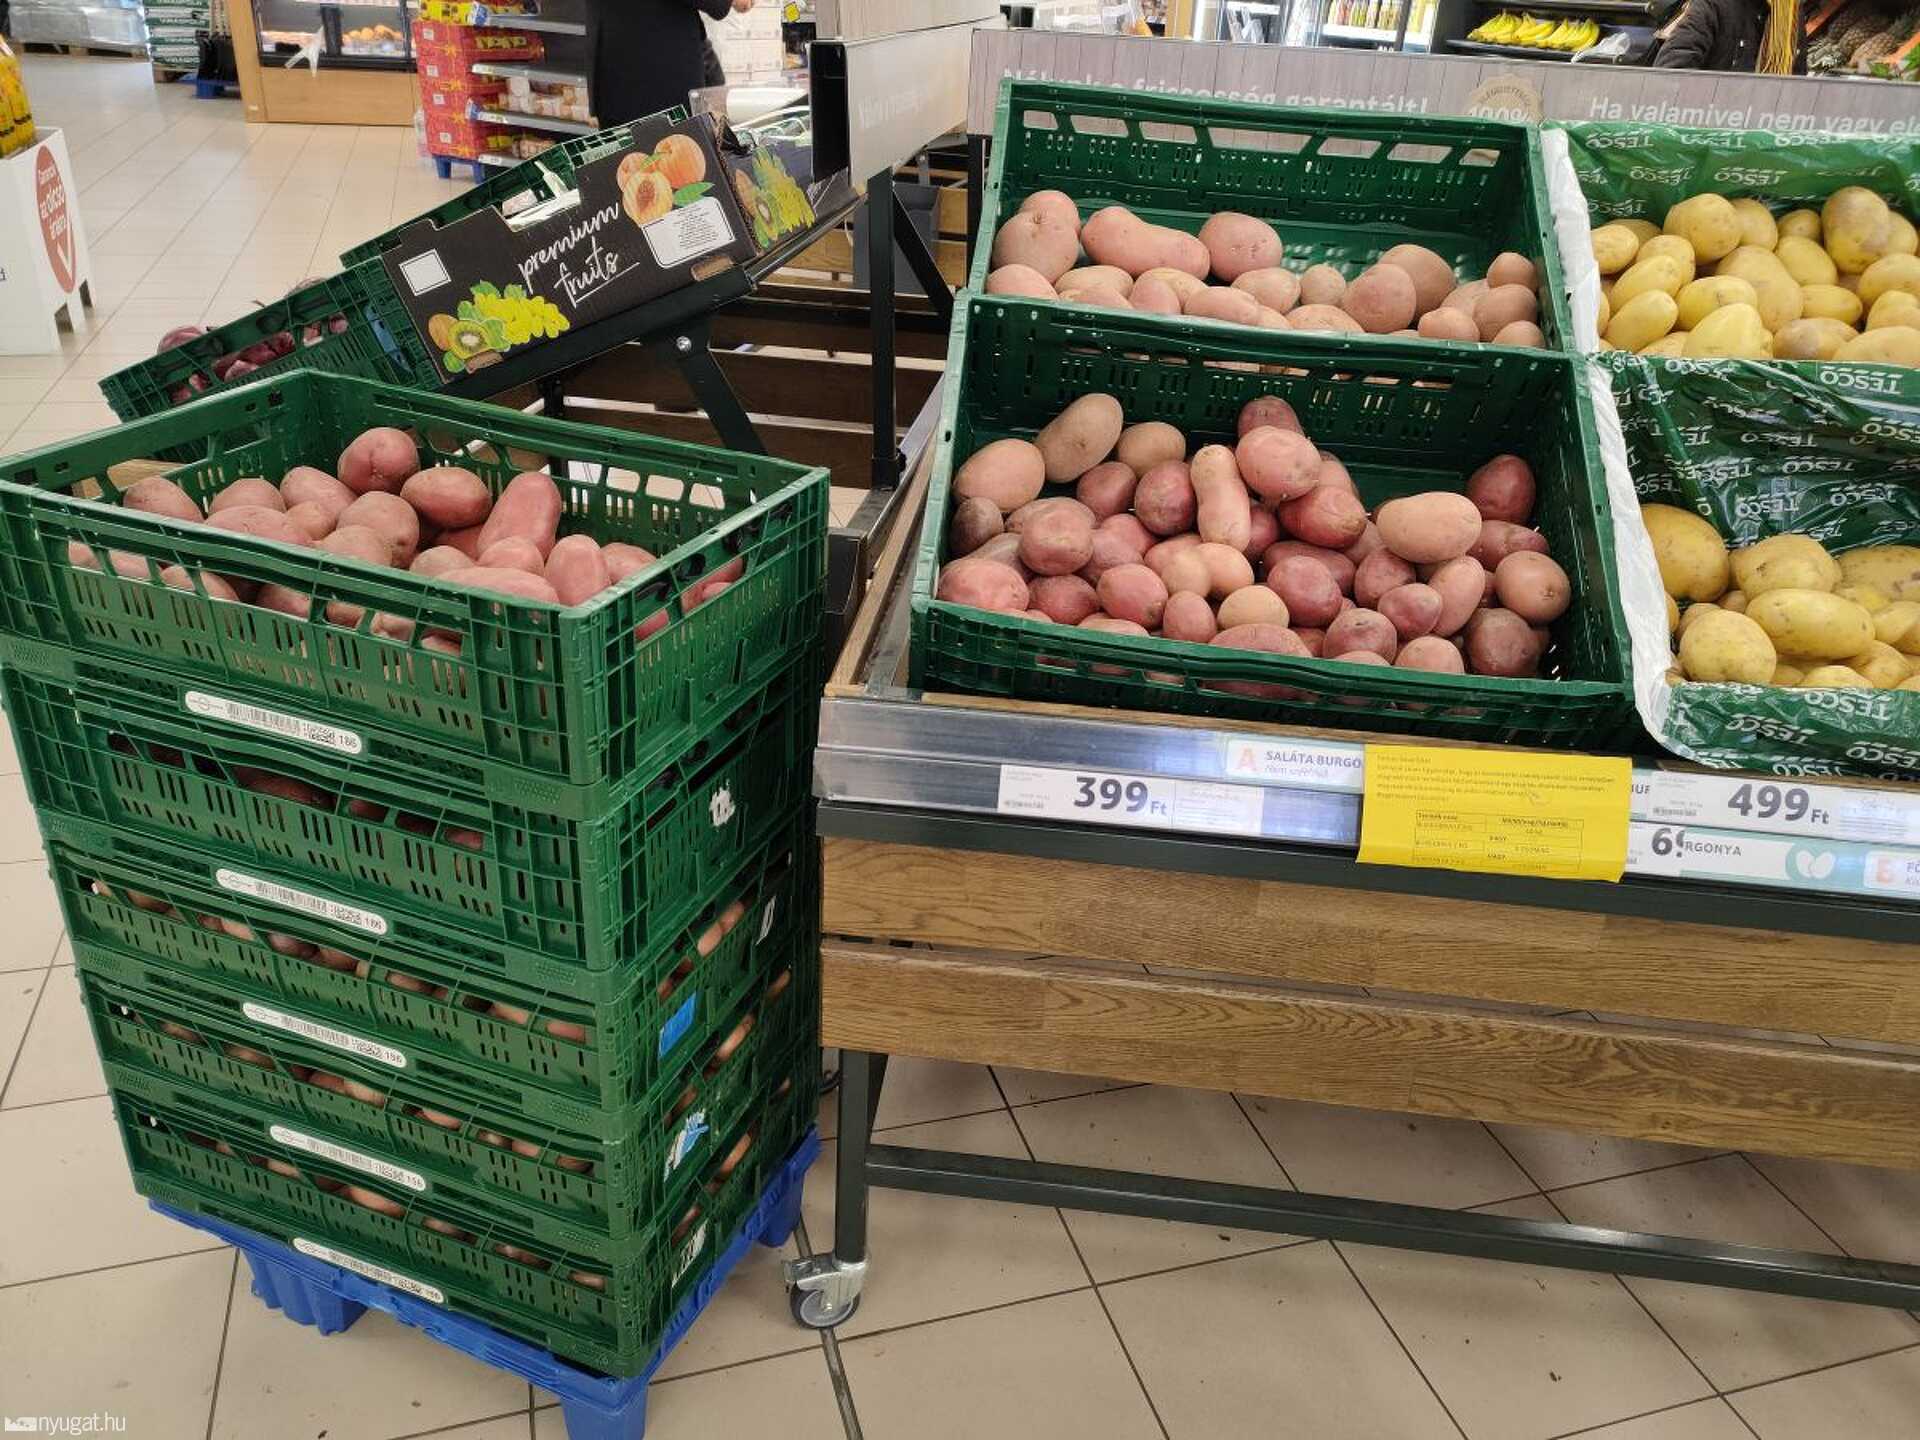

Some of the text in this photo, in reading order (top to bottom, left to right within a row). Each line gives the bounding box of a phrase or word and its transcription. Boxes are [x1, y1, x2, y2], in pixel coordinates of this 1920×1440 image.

[1589, 97, 1622, 119] Ha
[1631, 101, 1752, 128] valamivel
[1757, 112, 1816, 129] nem
[1825, 116, 1884, 133] vagy
[517, 203, 619, 294] premium
[553, 237, 620, 307] fruits
[1820, 370, 1903, 395] TESCO
[1862, 421, 1920, 444] ESCO
[1805, 691, 1892, 721] TESCO
[1726, 717, 1811, 746] TESCO
[1266, 750, 1315, 764] SALÁTA
[1316, 755, 1361, 769] BURGO
[1073, 776, 1148, 812] 399
[1151, 801, 1167, 815] Ft
[1728, 784, 1810, 821] 499
[1811, 809, 1829, 825] Ft
